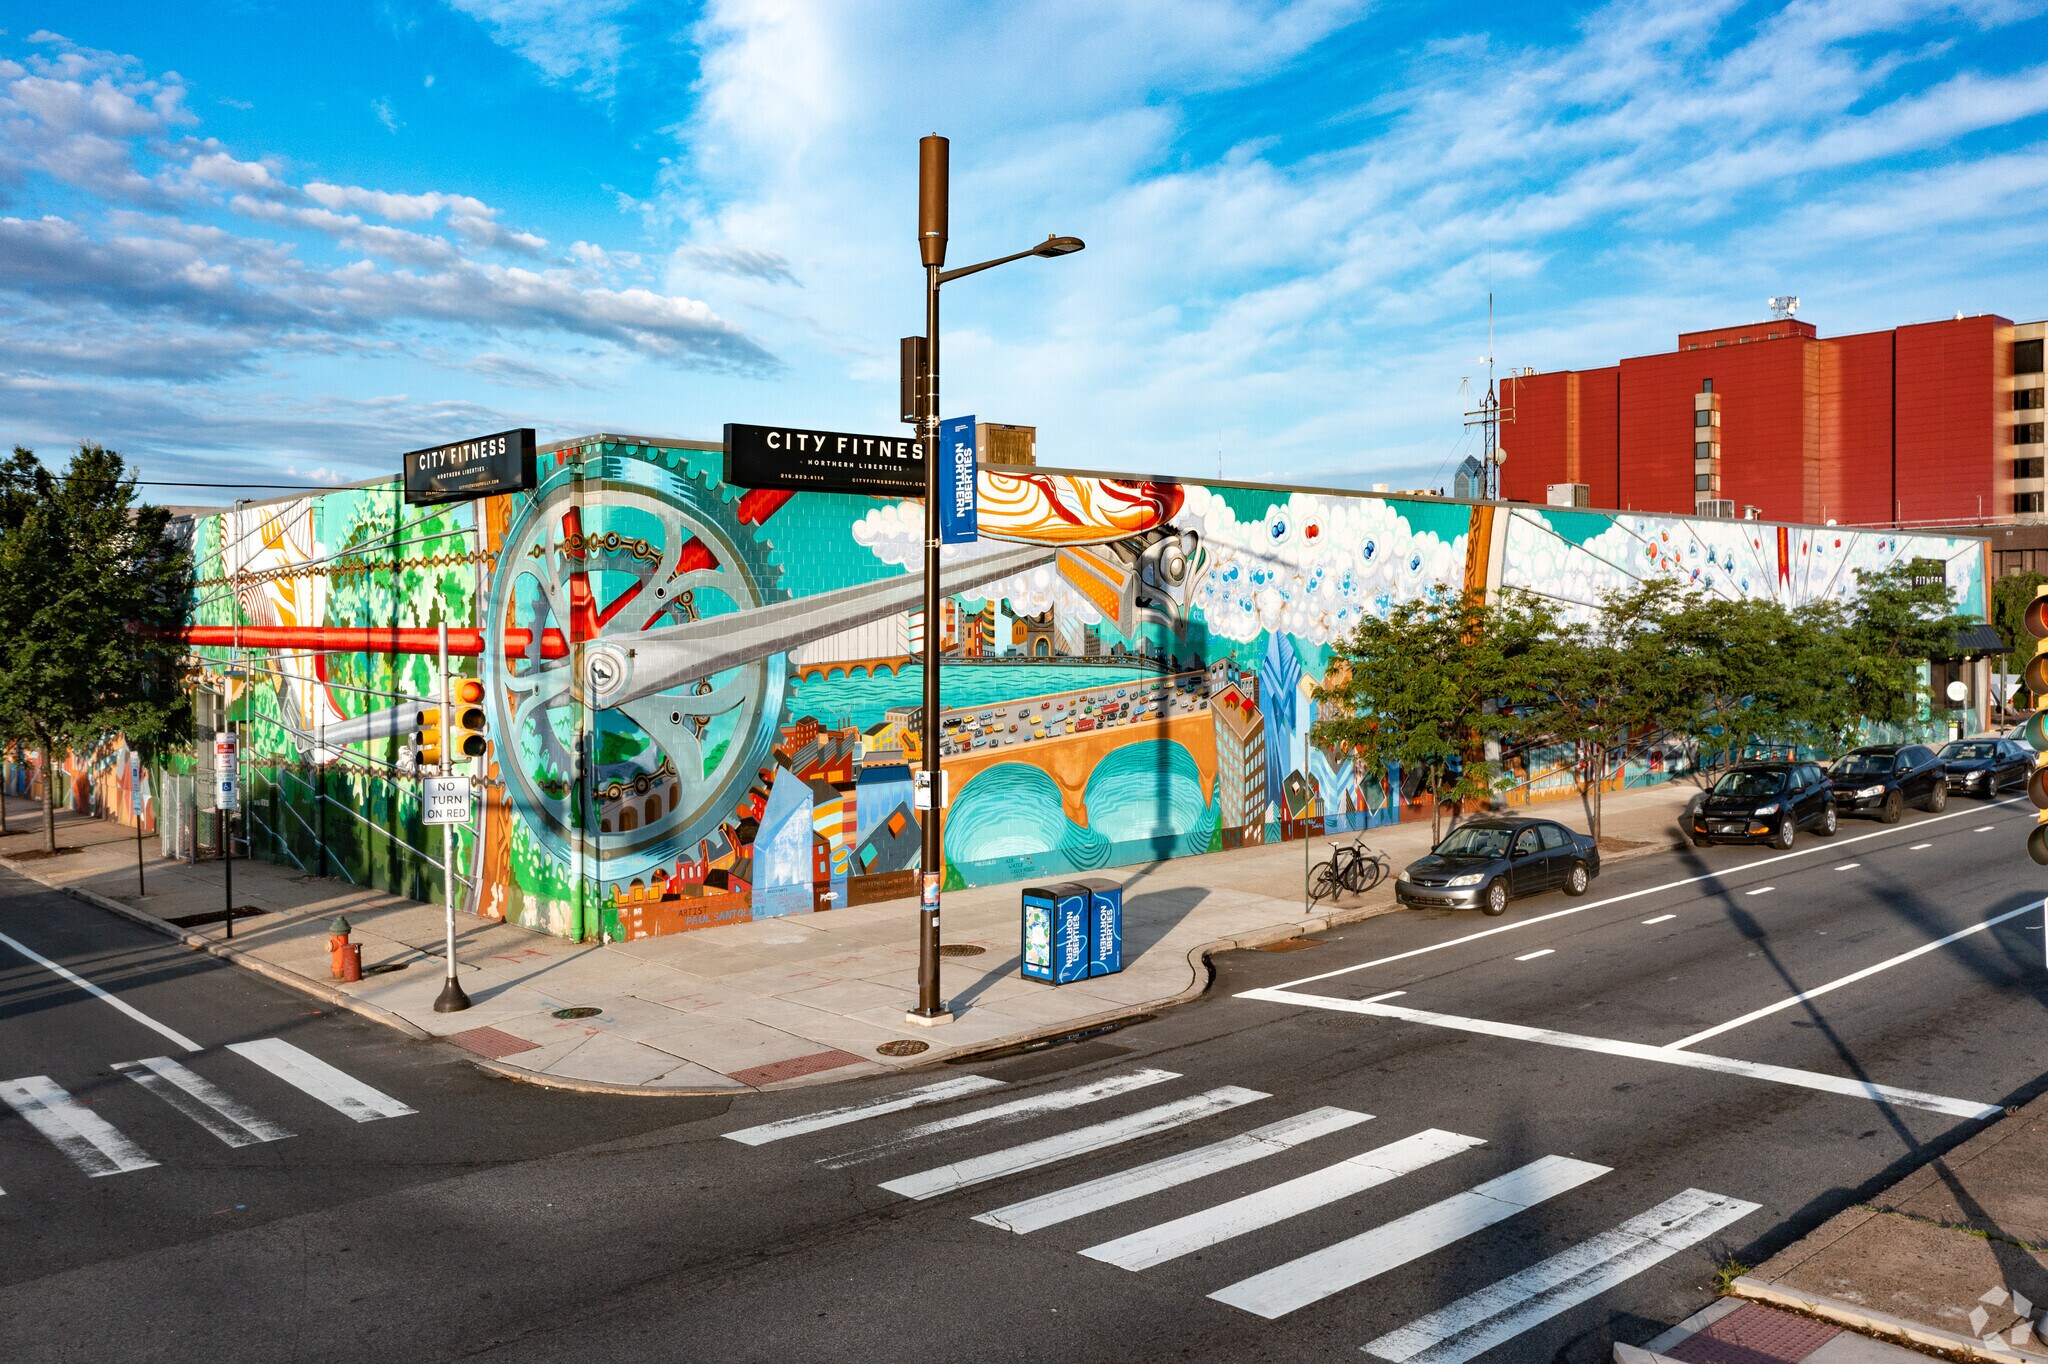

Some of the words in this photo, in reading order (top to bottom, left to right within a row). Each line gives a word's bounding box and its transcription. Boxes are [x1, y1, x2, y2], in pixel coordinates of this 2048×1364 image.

[419, 450, 446, 471] CITY
[450, 437, 506, 465] FITNESS
[766, 431, 826, 452] CITY
[837, 437, 924, 460] FITNES
[437, 471, 461, 480] NORTHERN
[462, 466, 485, 476] LIBERTIES
[807, 459, 854, 468] NORTHERN
[858, 463, 903, 472] LIBERTIES
[955, 442, 966, 518] NORTHERN
[964, 447, 974, 511] LIBERTIES
[1915, 575, 1943, 585] FITNESS
[437, 782, 455, 791] NO
[431, 795, 462, 805] TURN
[427, 809, 443, 819] ON
[446, 808, 466, 818] RED
[678, 906, 707, 917] ARTIST
[685, 914, 711, 925] PAUL
[713, 906, 766, 921] SANTOLERI
[1066, 911, 1074, 967] NORTHERN
[1072, 915, 1080, 962] LIBERTIES
[1105, 908, 1113, 955] LIBERTIES
